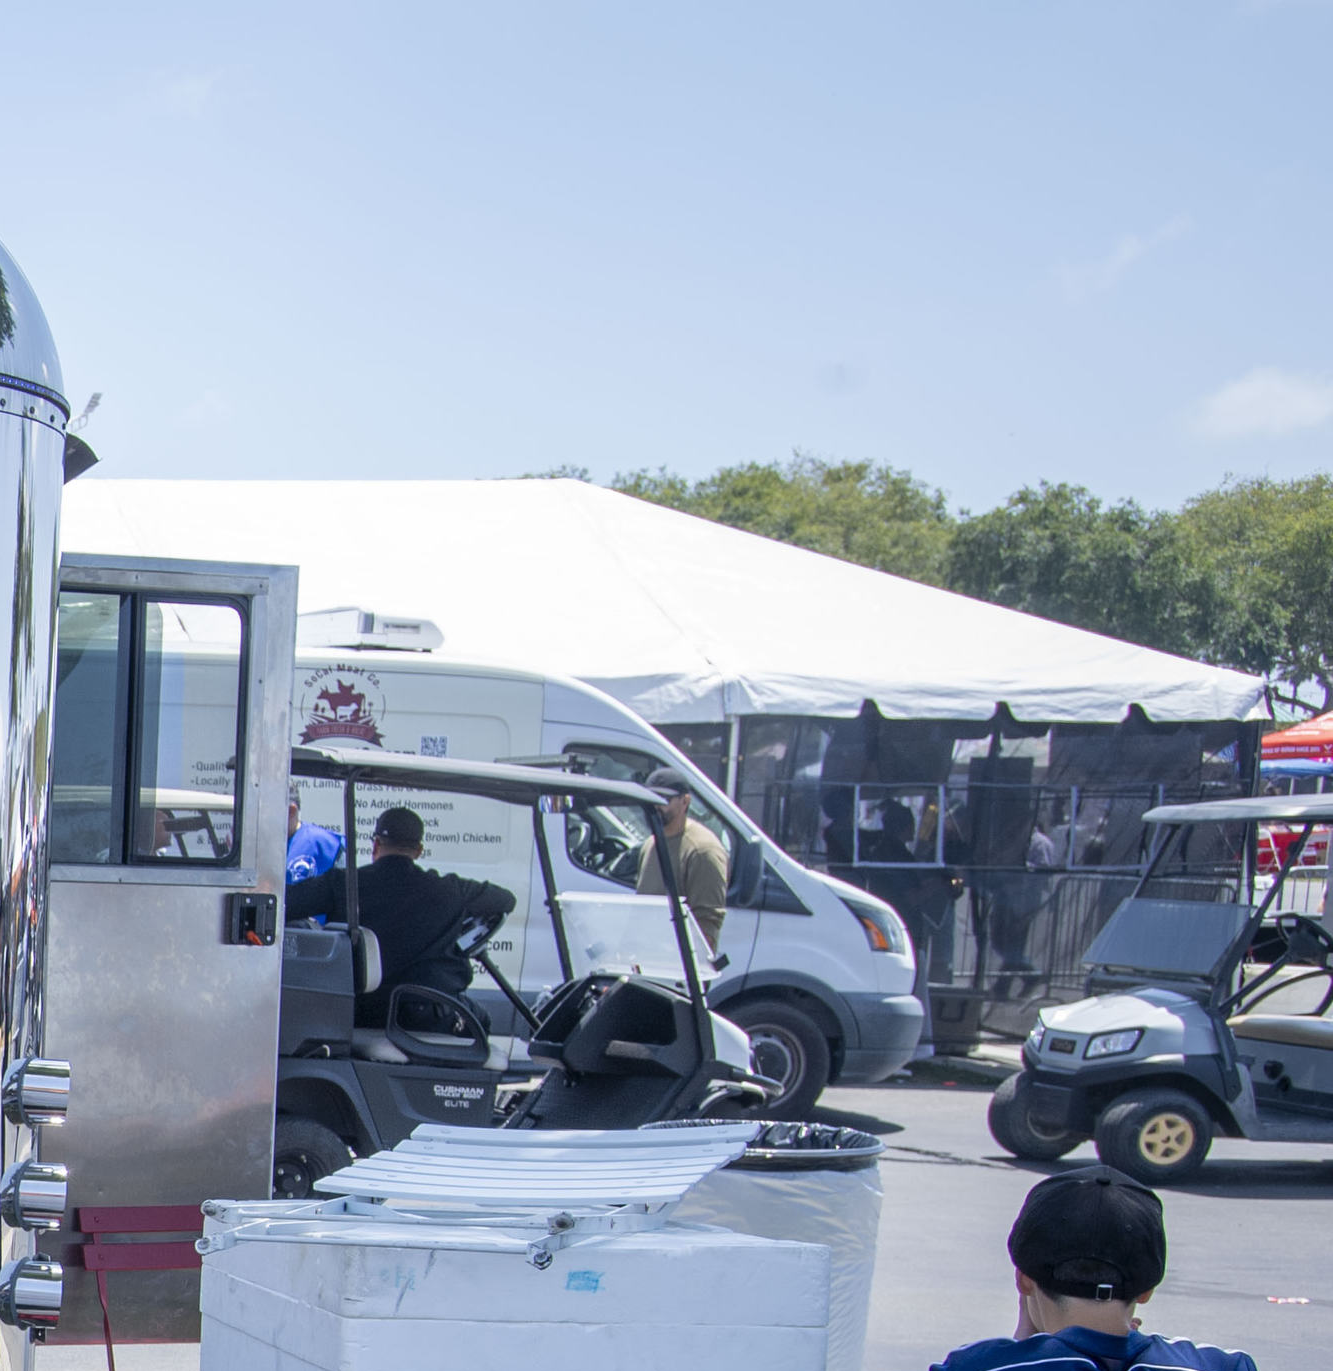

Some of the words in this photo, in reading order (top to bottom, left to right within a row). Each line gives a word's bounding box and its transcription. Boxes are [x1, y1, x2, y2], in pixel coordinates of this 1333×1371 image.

[304, 664, 333, 688] SoCal
[337, 663, 366, 676] Meat
[195, 776, 230, 788] Locally
[354, 800, 369, 809] No
[370, 800, 402, 810] Added
[404, 800, 454, 810] Hormones
[462, 832, 502, 844] Chicken
[433, 1084, 484, 1096] CUSHMAN
